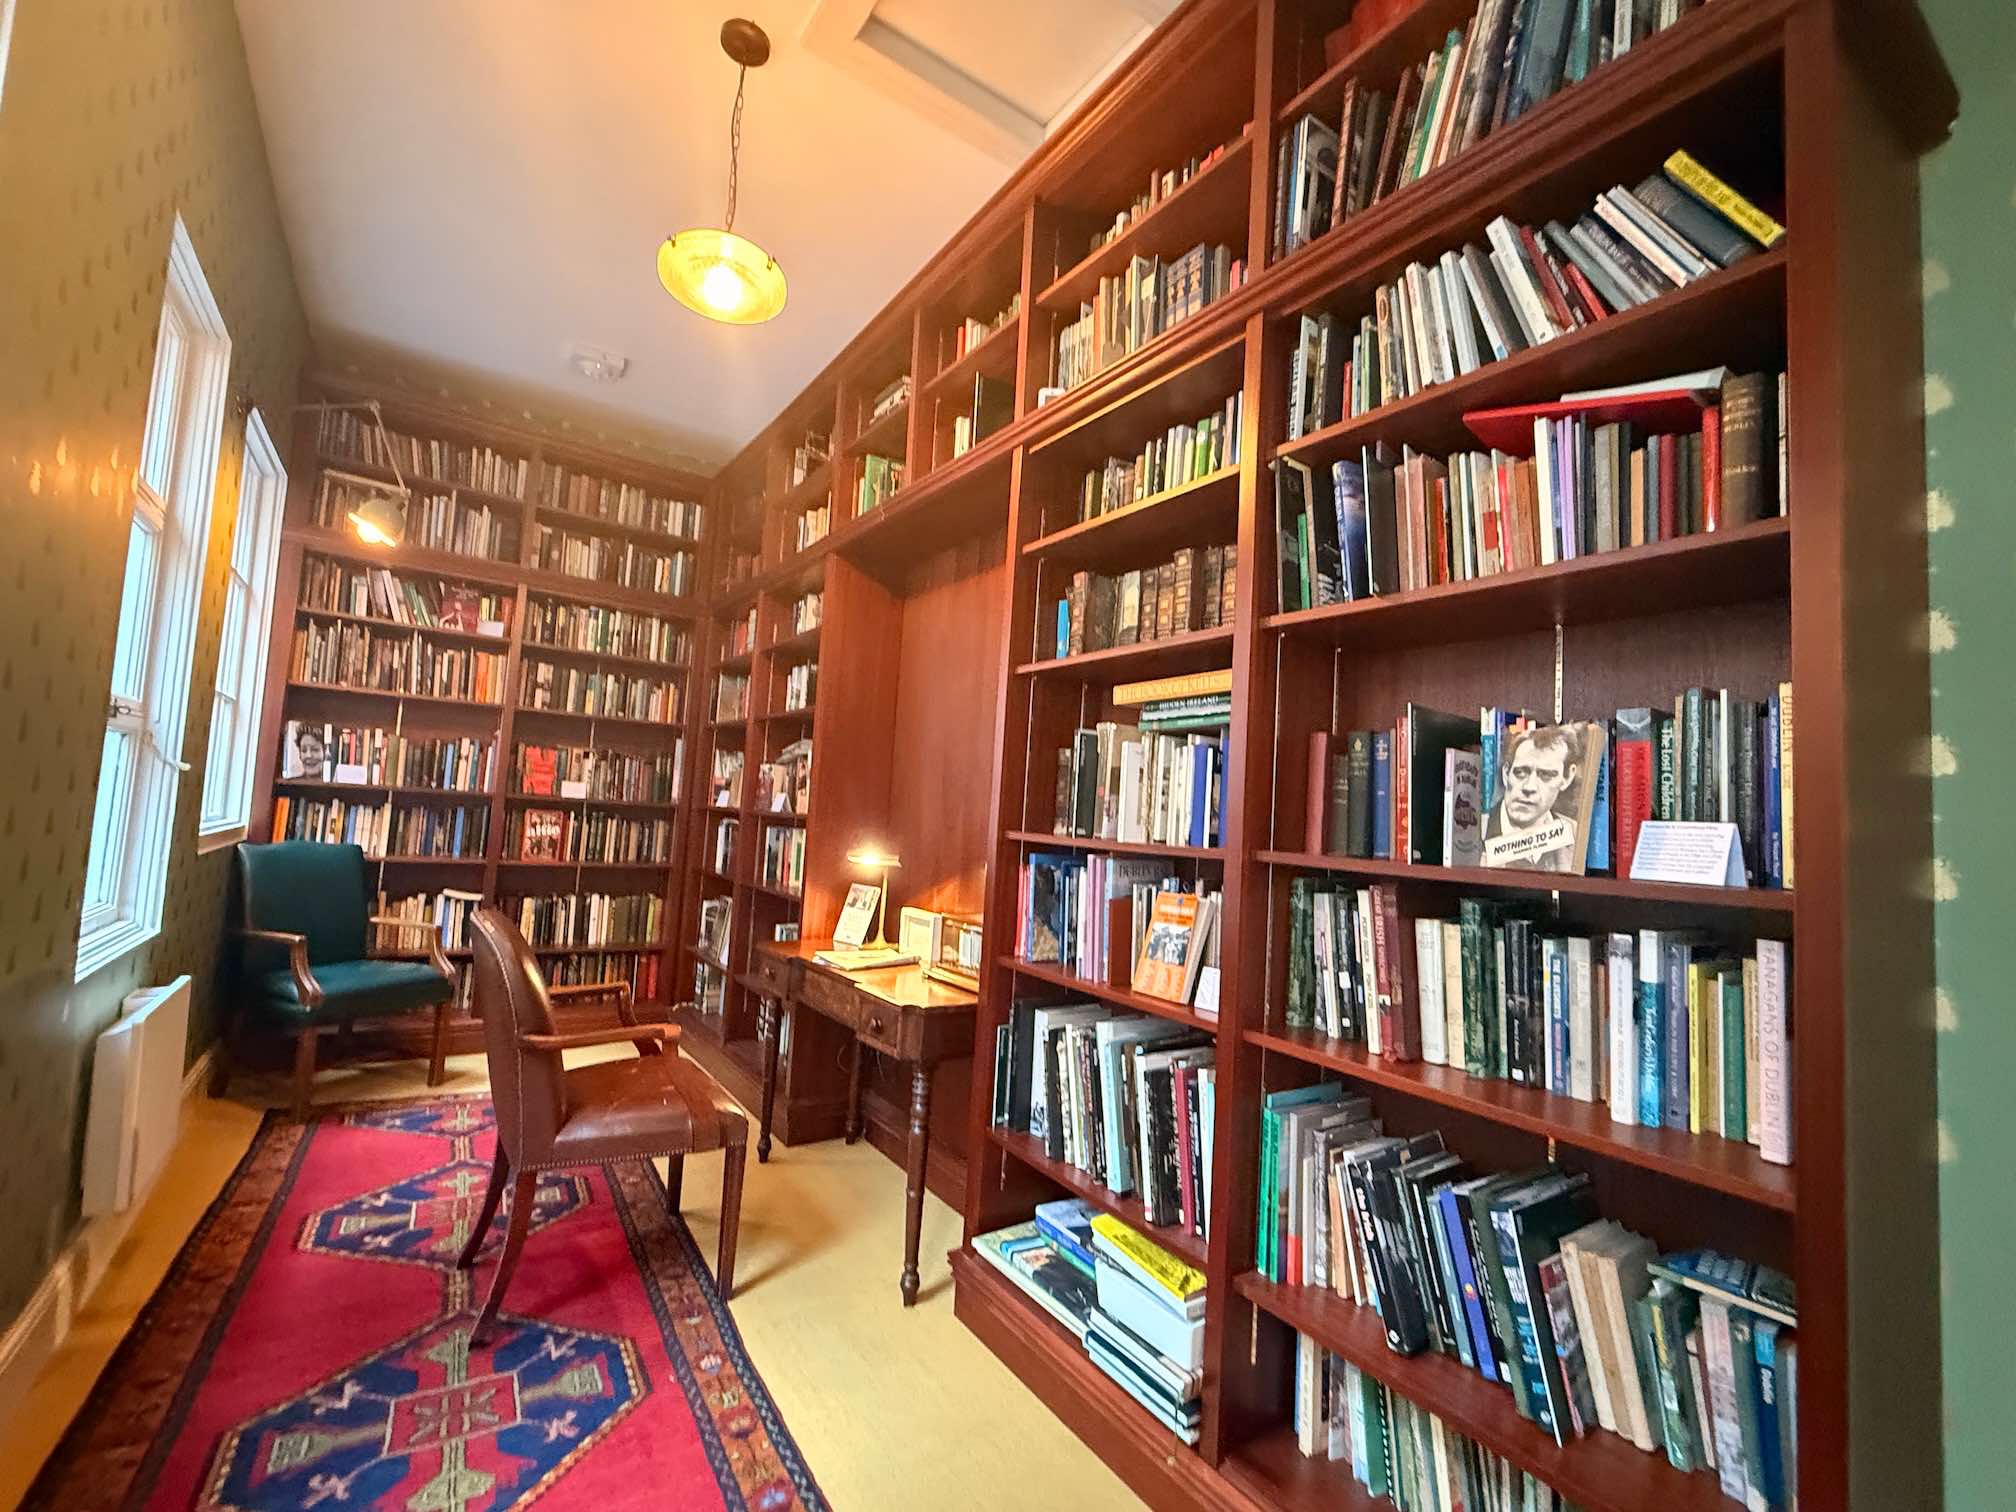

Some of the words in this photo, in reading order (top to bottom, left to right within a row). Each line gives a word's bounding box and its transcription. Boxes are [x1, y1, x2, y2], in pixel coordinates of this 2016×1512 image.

[1661, 727, 1674, 748] The
[1661, 749, 1673, 771] Lost
[1661, 773, 1673, 819] Children
[1493, 837, 1534, 854] NOTHING
[1536, 832, 1548, 843] TO
[1548, 827, 1565, 842] SAY
[1764, 1041, 1779, 1063] OF
[1765, 1068, 1781, 1127] DUBLIN
